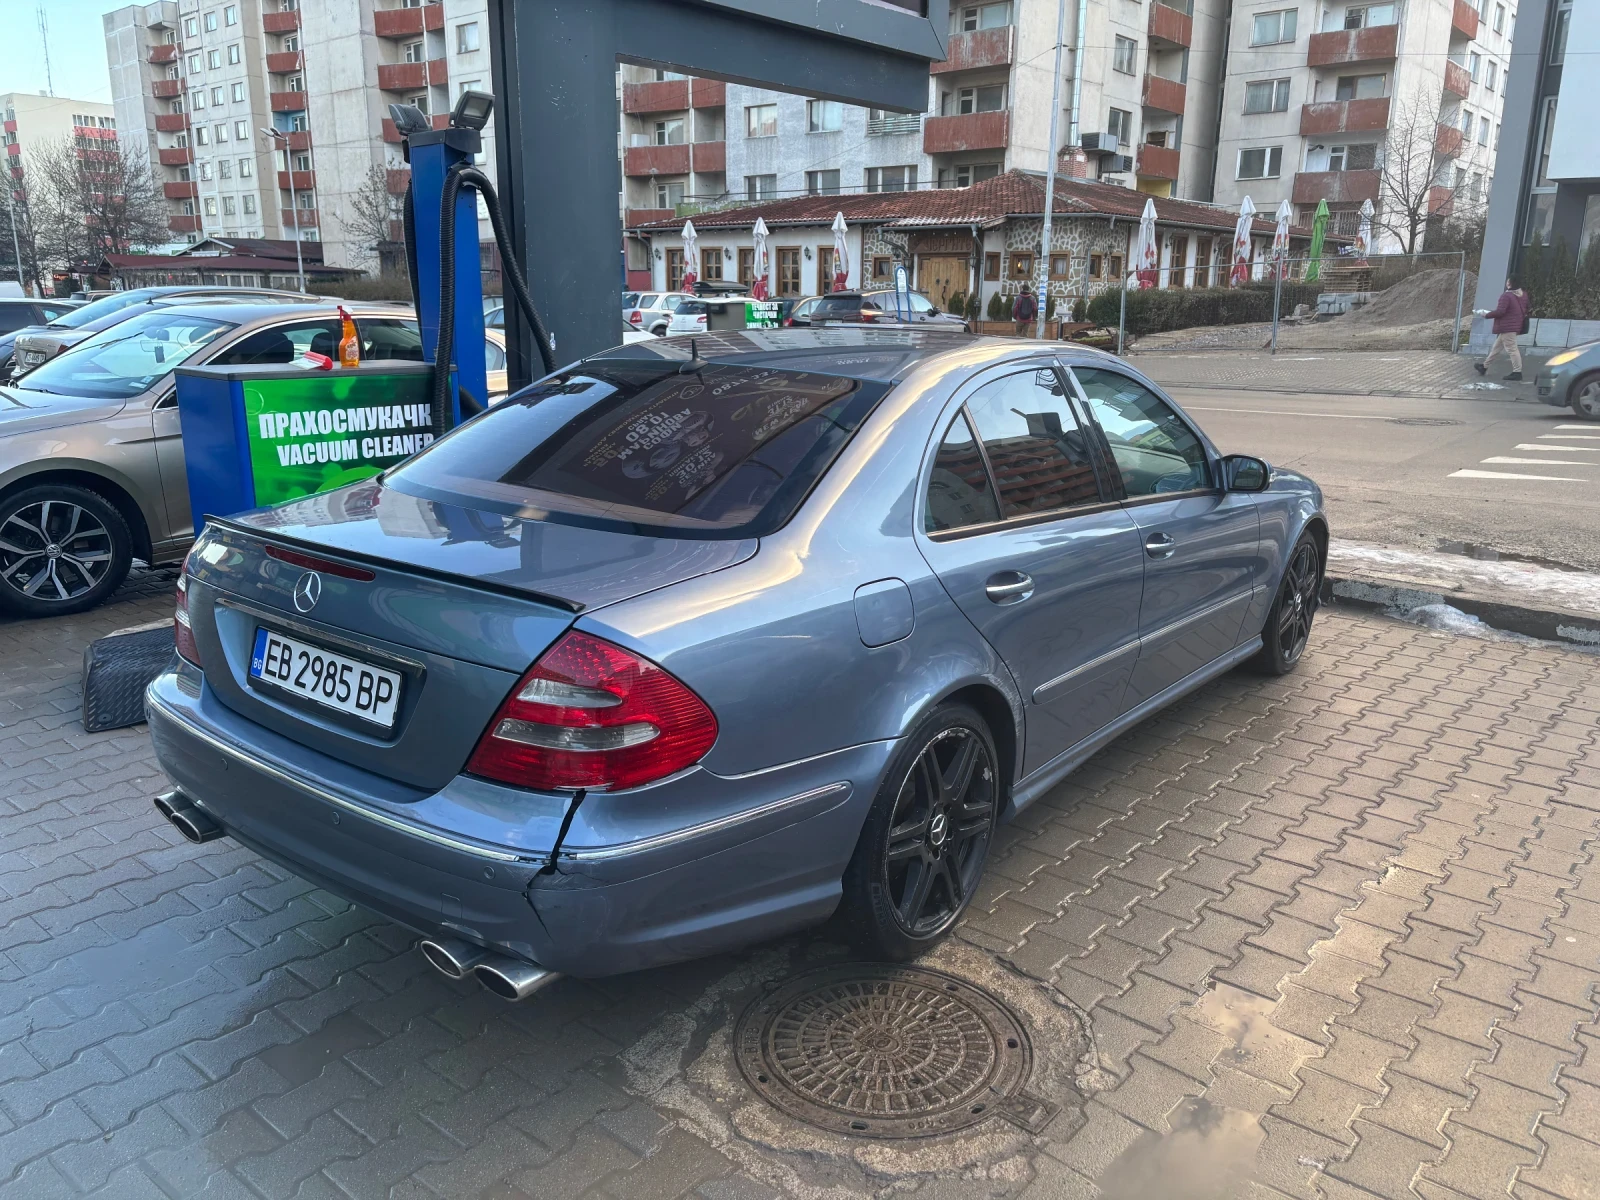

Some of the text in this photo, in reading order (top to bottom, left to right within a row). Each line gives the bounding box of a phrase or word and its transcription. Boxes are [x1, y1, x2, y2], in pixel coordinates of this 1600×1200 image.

[258, 403, 433, 439] ПРАХОСМУКАЧК
[276, 439, 358, 467] VACUUM
[253, 657, 262, 670] BG
[264, 638, 393, 715] EB 2985 BP
